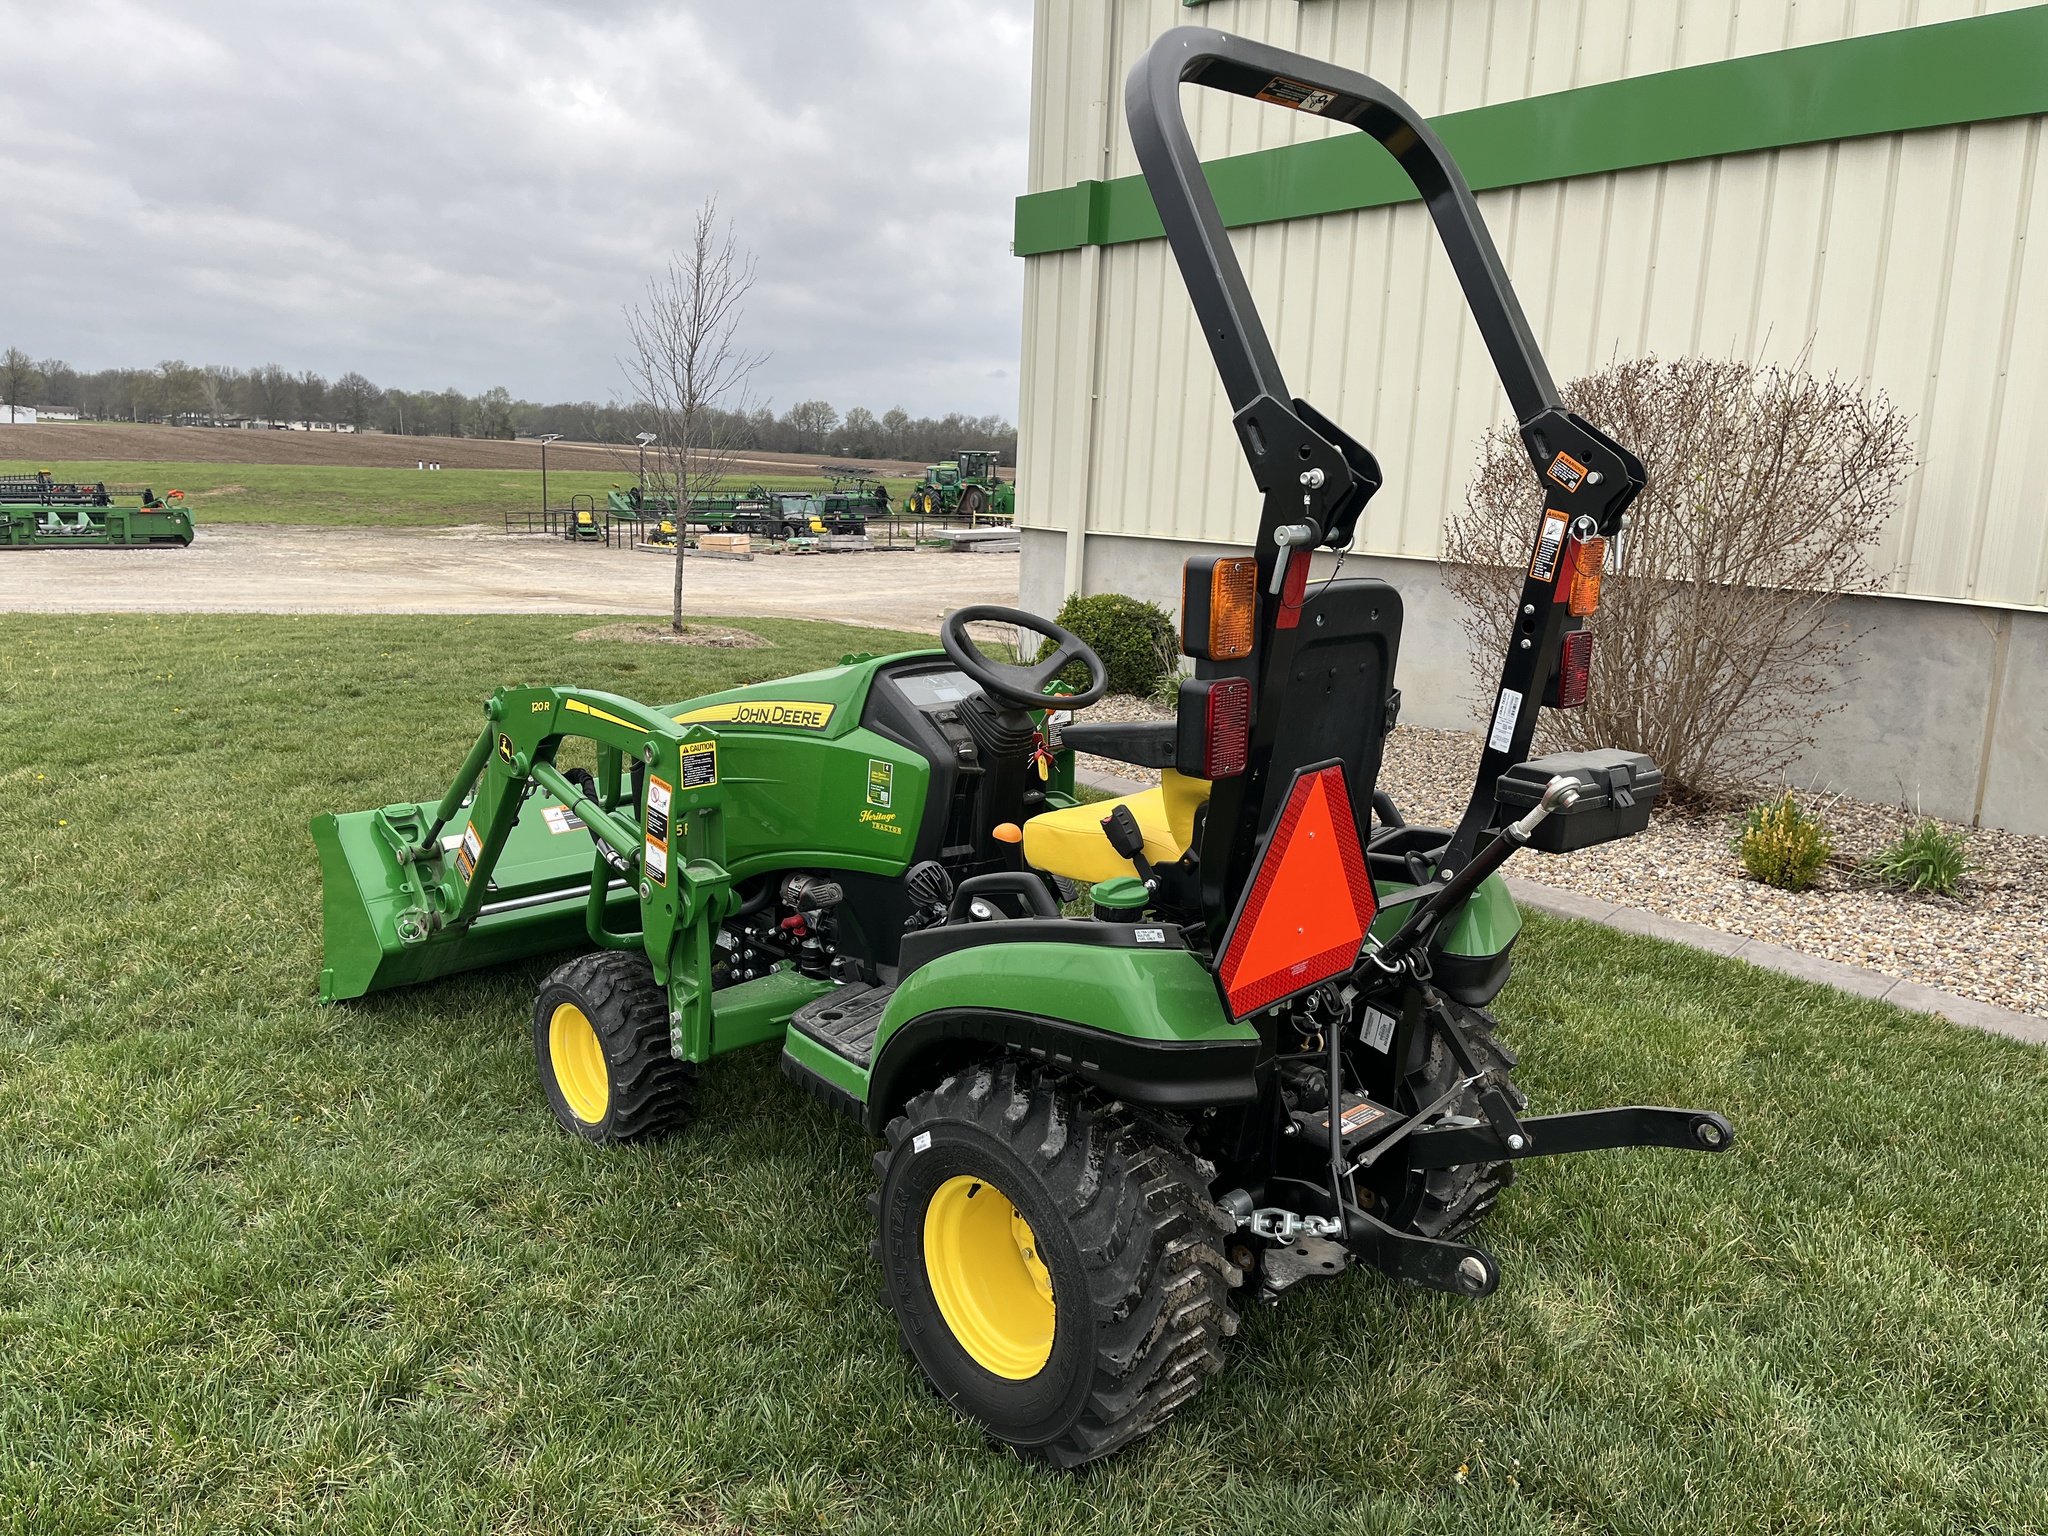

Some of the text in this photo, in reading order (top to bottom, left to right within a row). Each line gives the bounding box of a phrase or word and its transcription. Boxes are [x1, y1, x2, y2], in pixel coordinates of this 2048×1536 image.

[731, 705, 822, 725] JOHN DEERE
[689, 742, 714, 753] CAUTION
[859, 810, 896, 823] Heritage
[891, 1186, 926, 1337] CARLSTAR
